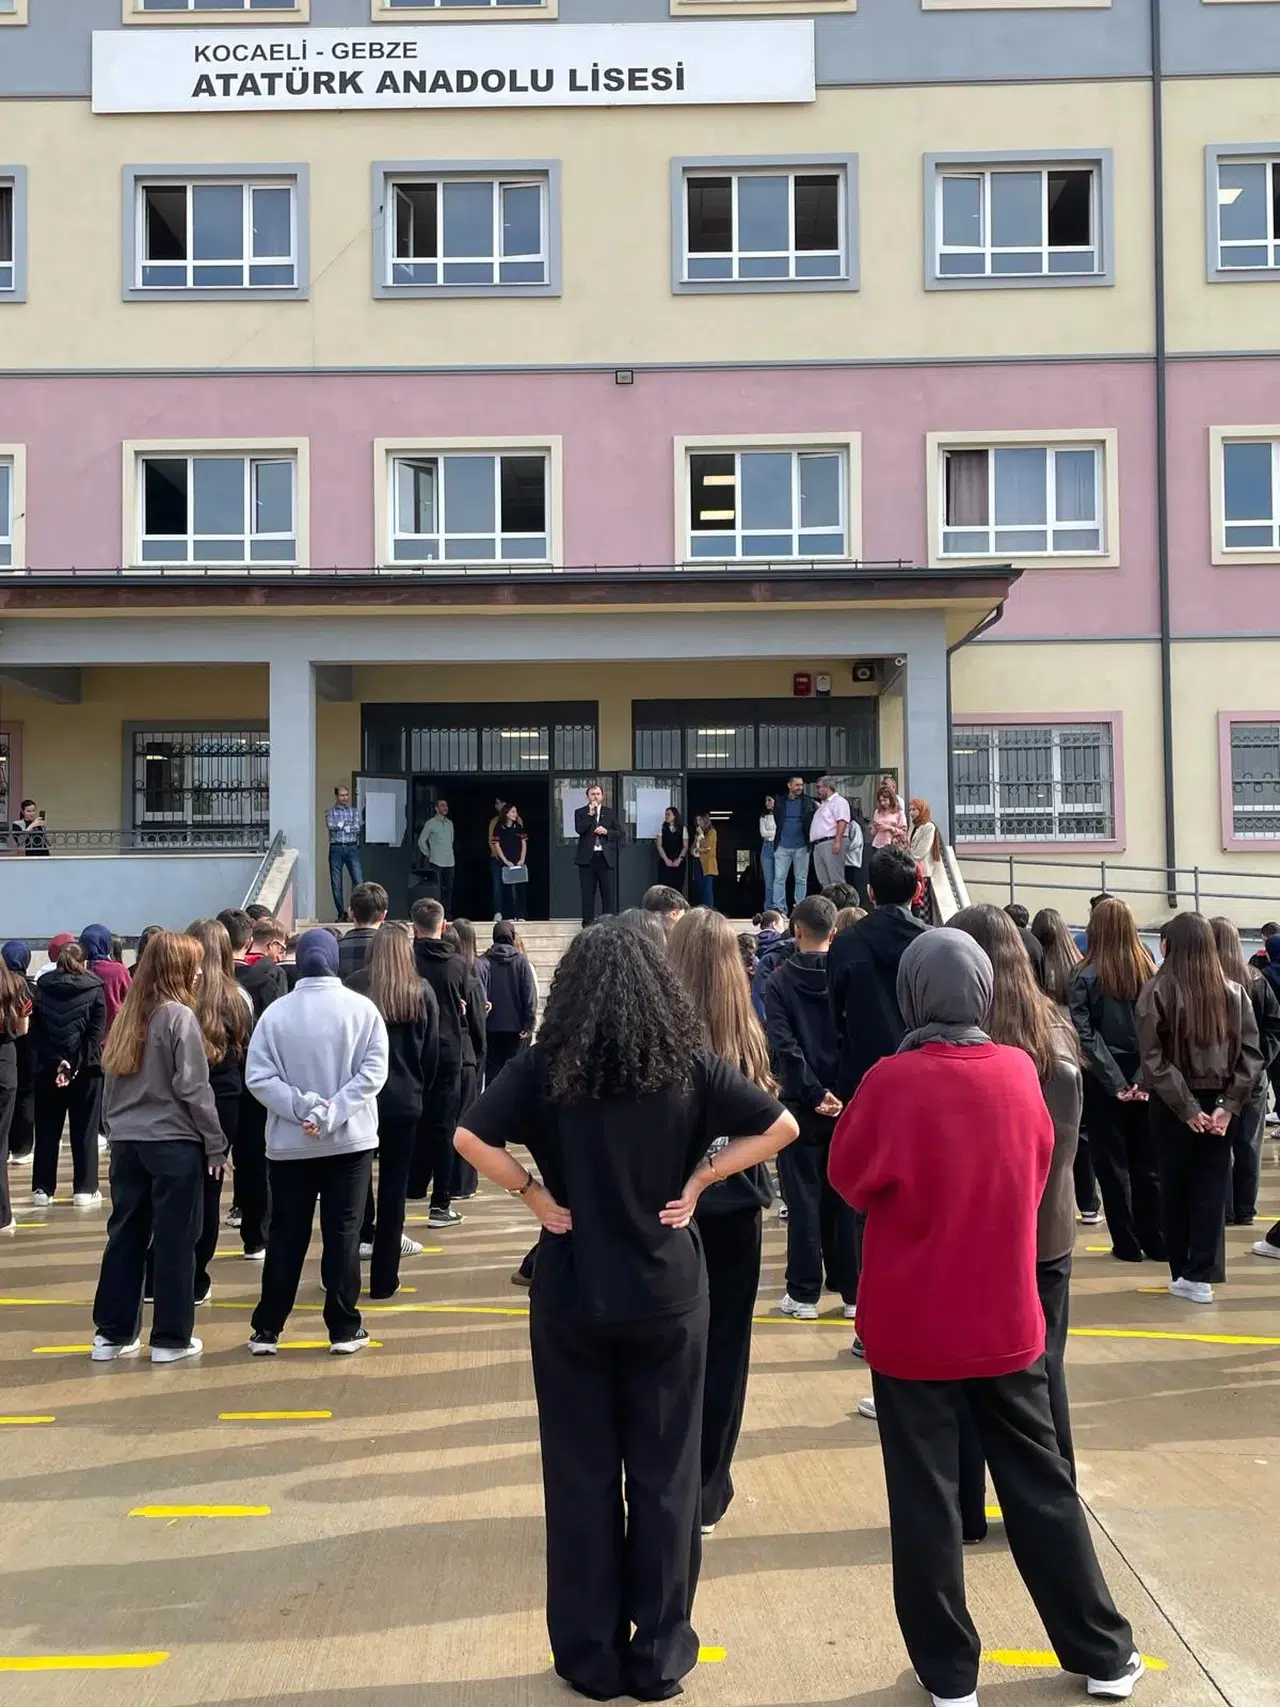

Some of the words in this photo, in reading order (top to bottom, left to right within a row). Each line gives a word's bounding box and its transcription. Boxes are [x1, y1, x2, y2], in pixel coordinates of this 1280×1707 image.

[194, 39, 307, 63] KOCAELİ
[331, 42, 418, 60] GEBZE
[191, 67, 365, 98] ATATÜRK
[375, 68, 554, 94] ANADOLU
[569, 61, 685, 92] LİSESİ
